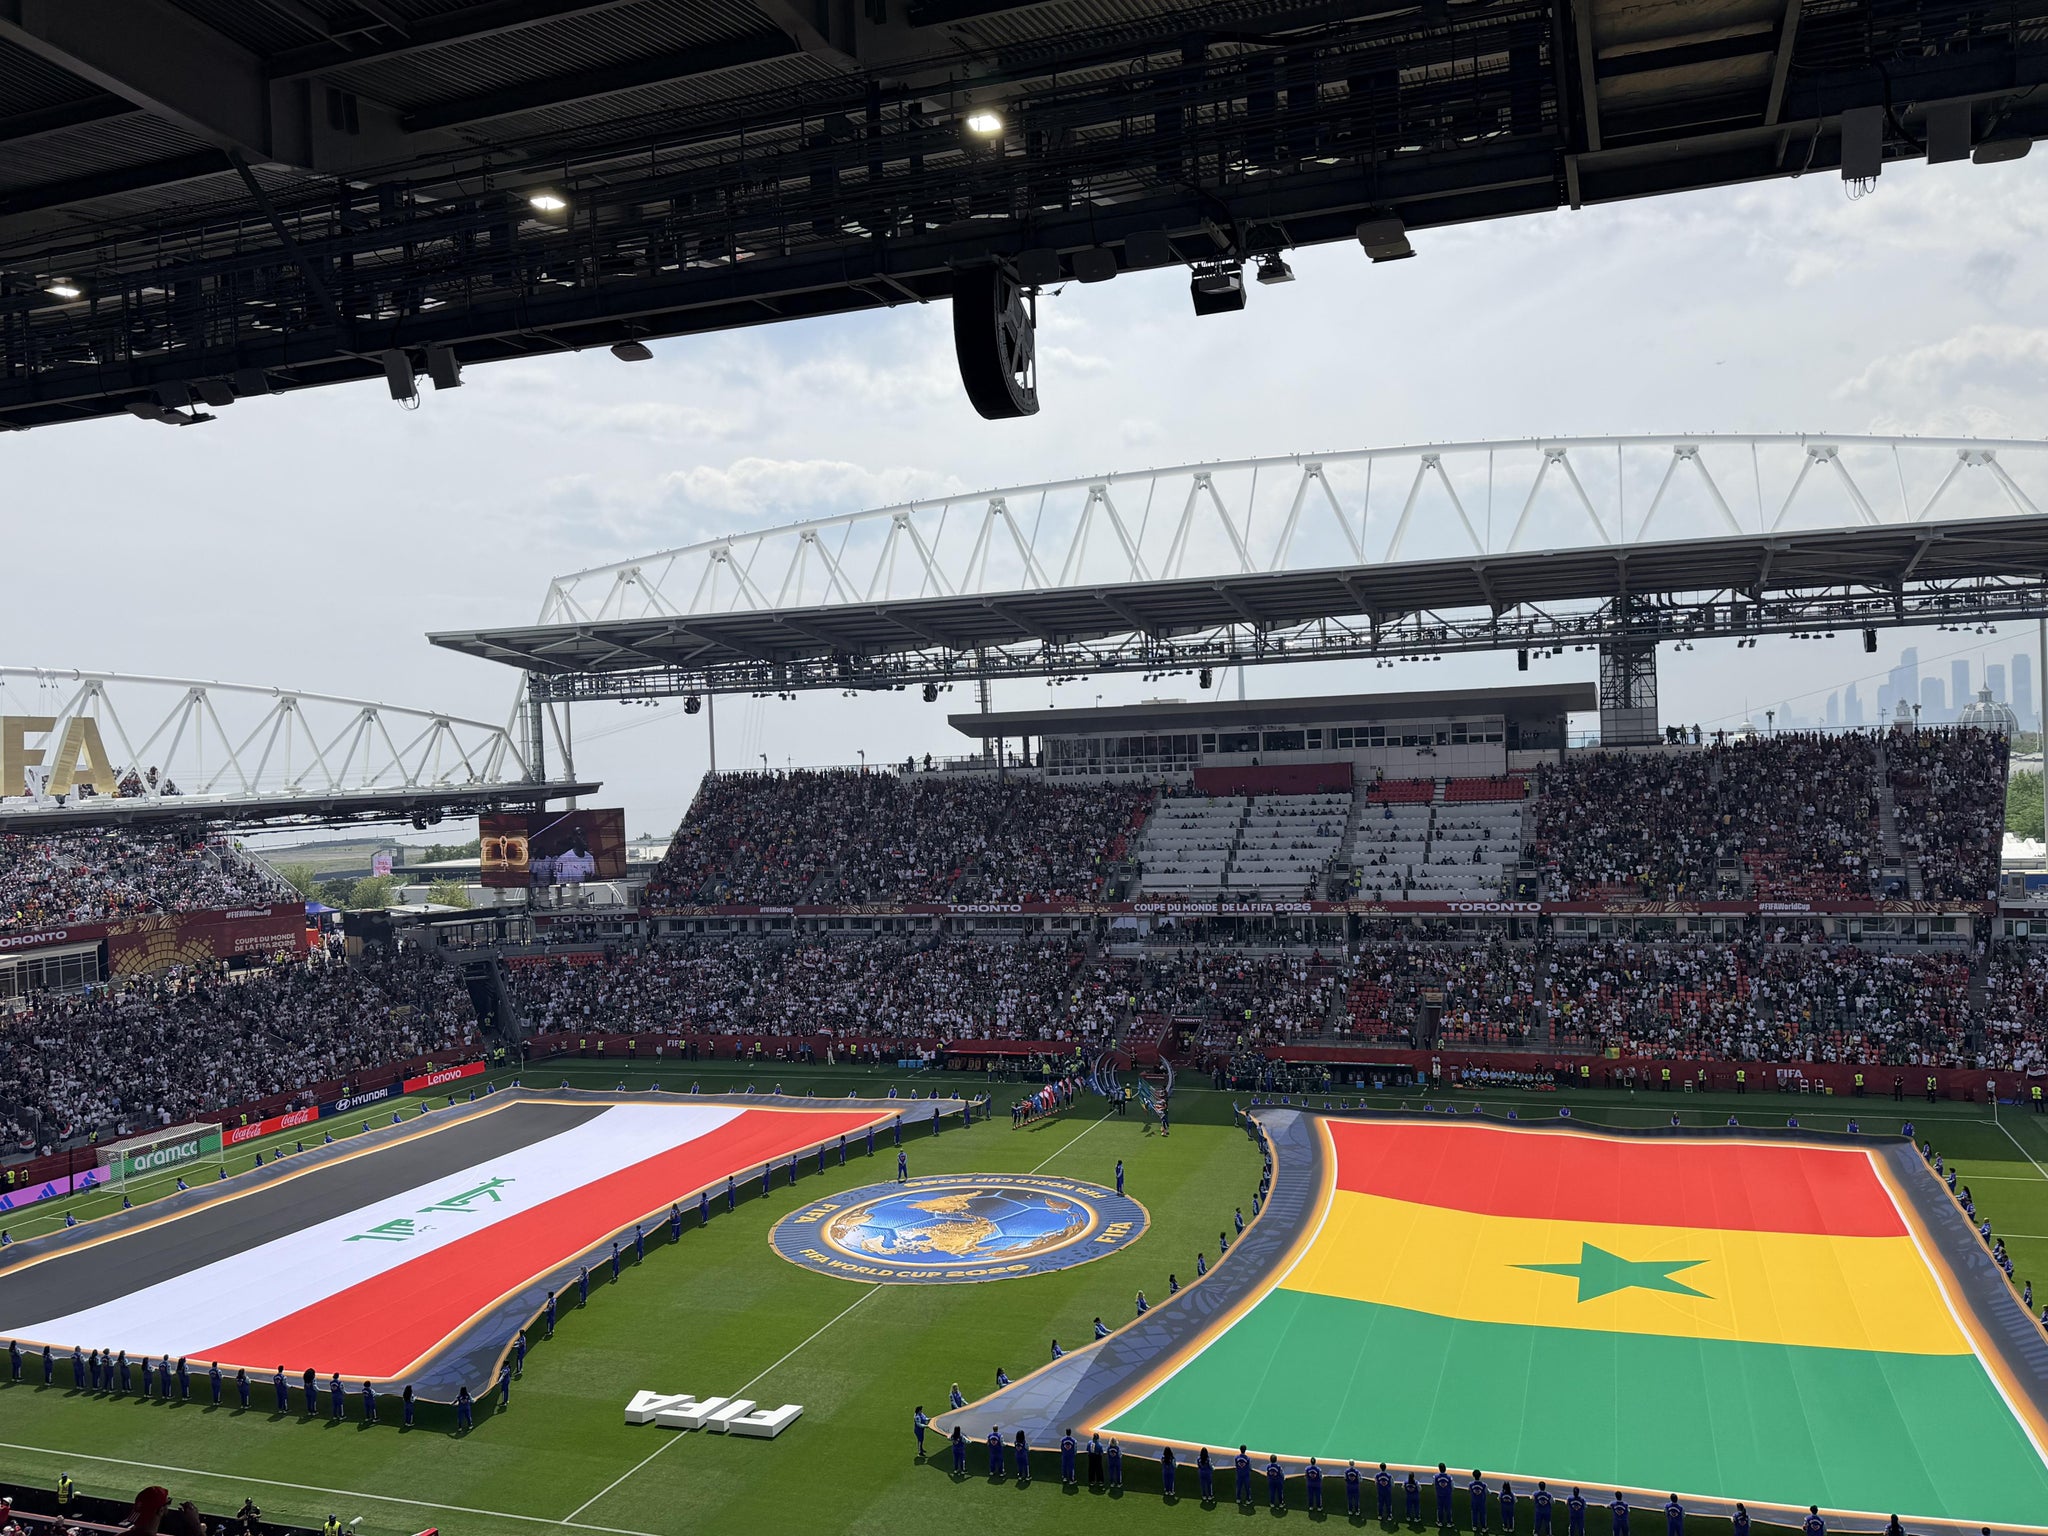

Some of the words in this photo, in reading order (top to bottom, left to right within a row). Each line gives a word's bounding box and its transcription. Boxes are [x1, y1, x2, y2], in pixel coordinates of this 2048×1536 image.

[947, 904, 1022, 913] TORONTO
[1134, 903, 1166, 912] COUPE
[1167, 903, 1180, 912] DU
[1182, 903, 1218, 912] MONDE
[1221, 903, 1235, 912] DE
[1236, 903, 1250, 912] LA
[1251, 903, 1273, 912] FIFA
[1275, 903, 1312, 912] 2026
[1446, 902, 1542, 912] TORONTO
[1759, 902, 1811, 911] #FIFAWorldCup
[550, 914, 625, 924] TORONTO
[234, 936, 259, 945] COUPE
[259, 935, 270, 943] DU
[270, 932, 296, 941] MONDE
[271, 939, 297, 948] 2026
[427, 1069, 462, 1085] Lenovo
[1776, 1068, 1804, 1078] FIFA
[351, 1088, 388, 1106] HYUNDAI
[1015, 1178, 1075, 1190] WORLD
[794, 1203, 841, 1224] FIFA
[1094, 1221, 1133, 1244] FIFA
[799, 1248, 830, 1263] FIFA
[828, 1260, 894, 1277] WORLD
[946, 1264, 1030, 1278] 2026
[624, 1389, 804, 1438] FIFA
